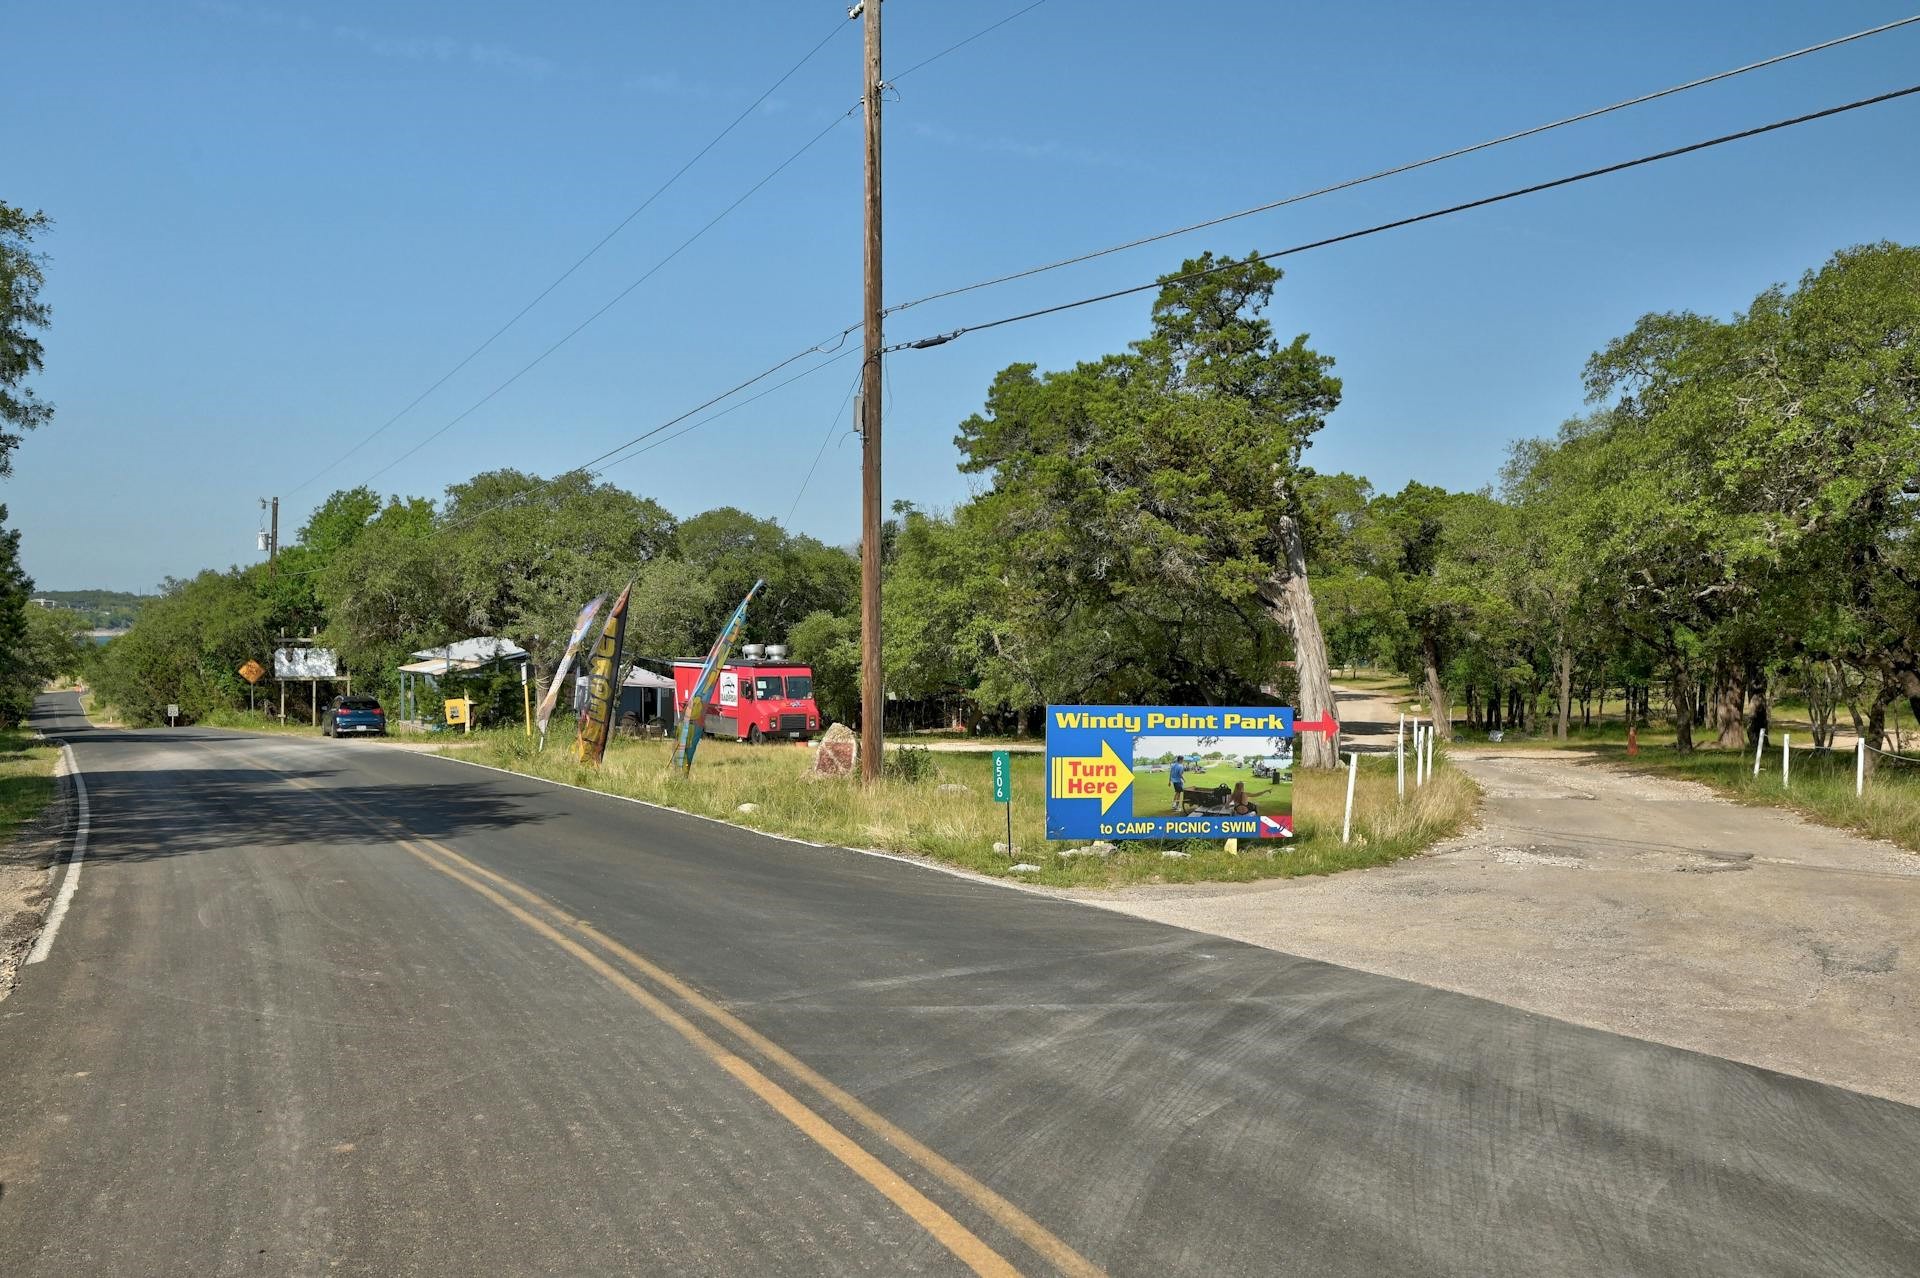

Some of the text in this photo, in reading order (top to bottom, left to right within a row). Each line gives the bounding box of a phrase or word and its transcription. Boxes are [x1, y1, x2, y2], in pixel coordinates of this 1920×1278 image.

[1055, 712, 1285, 733] Windy Point Park
[995, 756, 1003, 798] 6506
[1068, 761, 1117, 777] Turn
[1068, 778, 1118, 794] Here
[1100, 821, 1257, 834] to CAMP PICNIC SWIM
